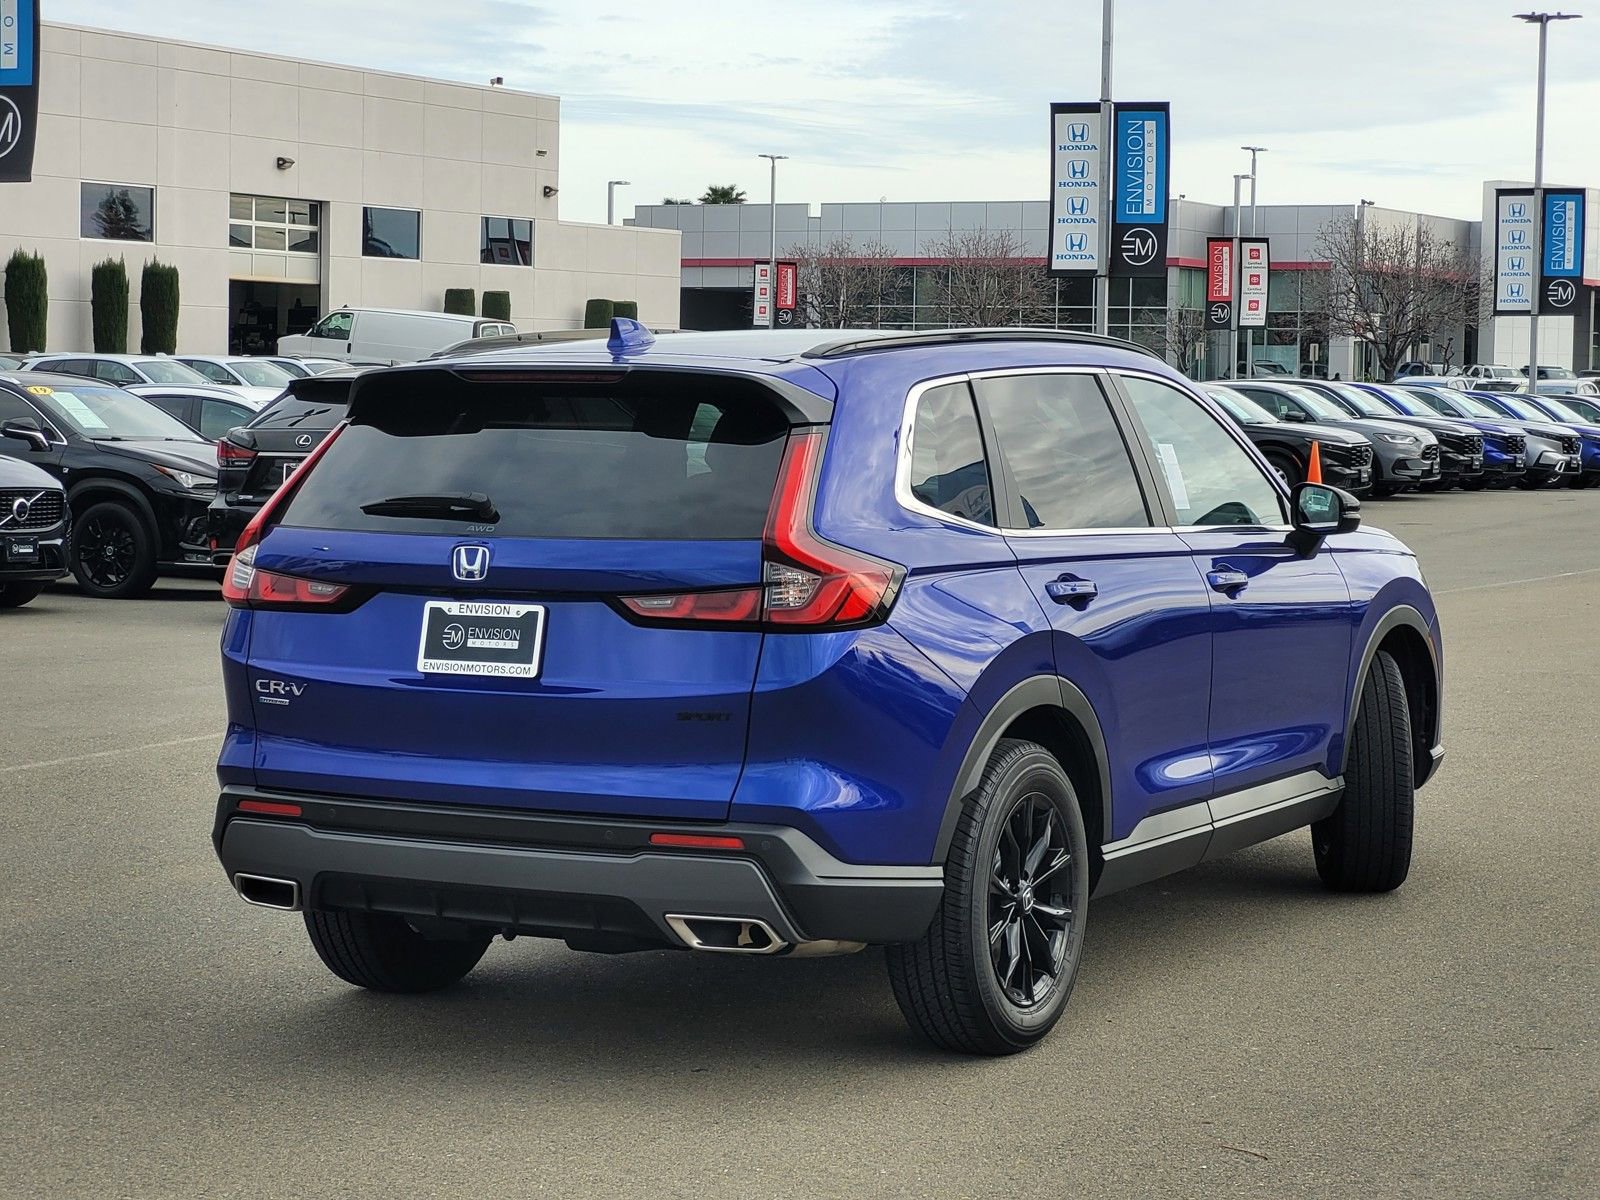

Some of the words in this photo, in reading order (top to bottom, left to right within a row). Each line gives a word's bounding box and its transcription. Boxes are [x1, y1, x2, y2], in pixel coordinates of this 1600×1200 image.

[1126, 120, 1143, 215] ENVISION
[1146, 129, 1154, 207] MOTORS
[1551, 200, 1566, 270] ENVISION
[780, 268, 788, 305] ENVISION
[1213, 246, 1223, 297] ENVISION
[458, 604, 511, 615] ENVISION
[468, 627, 520, 640] ENVISION
[423, 661, 531, 675] ENVISIONMOTORS.COM
[255, 679, 308, 696] CR-V
